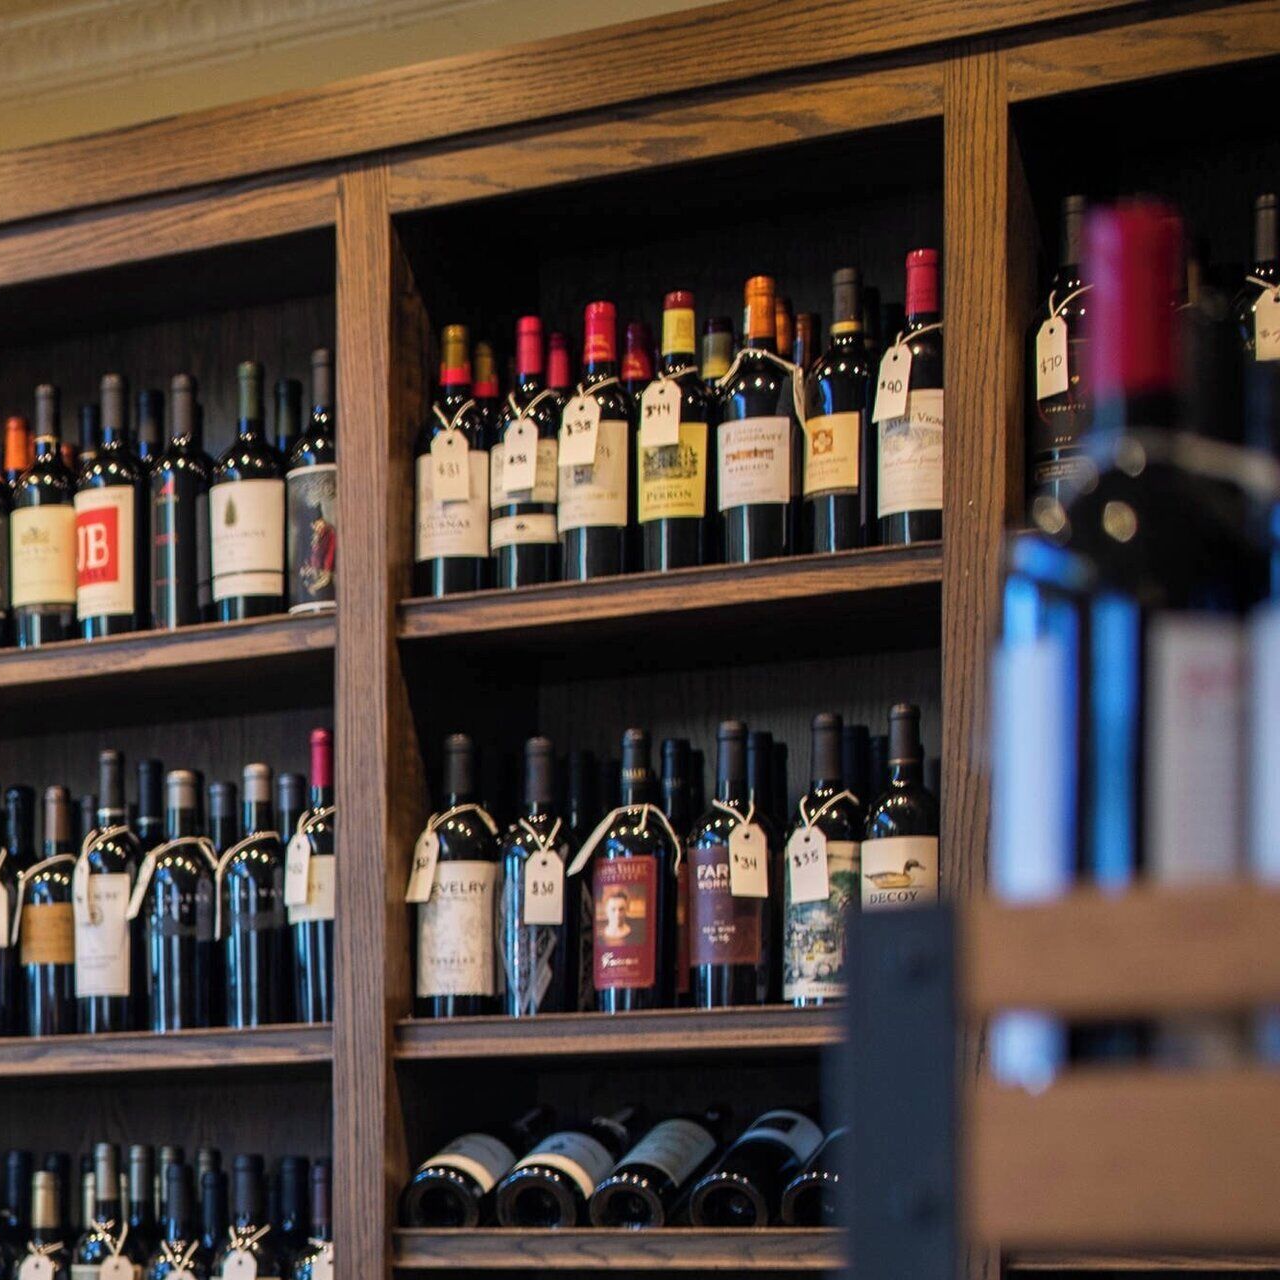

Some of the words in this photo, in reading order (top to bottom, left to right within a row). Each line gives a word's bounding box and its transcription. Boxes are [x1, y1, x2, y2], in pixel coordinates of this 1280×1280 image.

[1039, 355, 1062, 376] $70
[880, 379, 903, 394] $90
[734, 852, 758, 871] $34
[869, 889, 919, 905] DECOY
